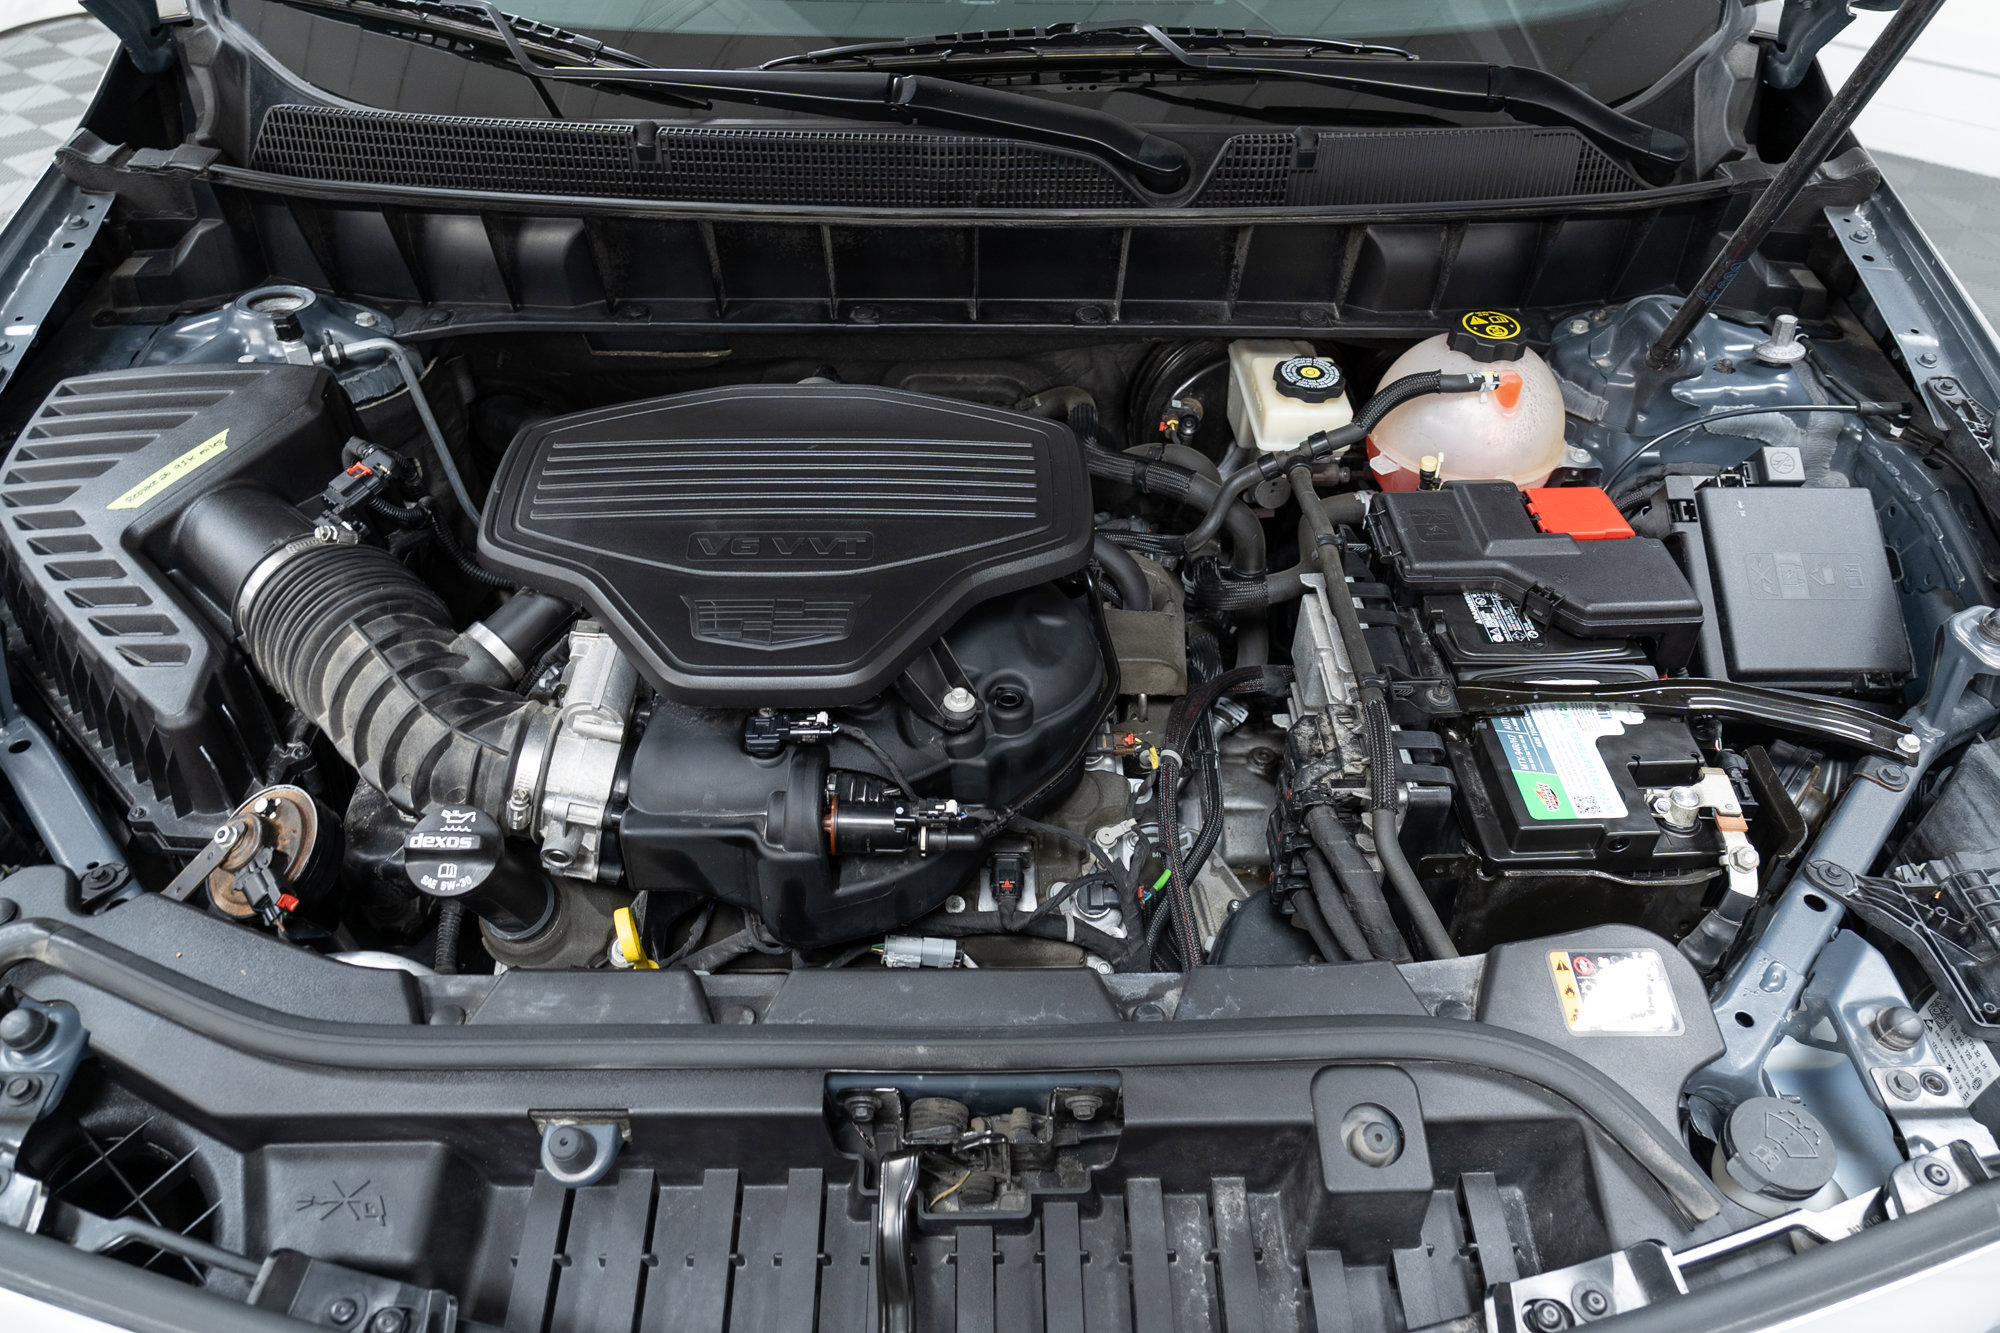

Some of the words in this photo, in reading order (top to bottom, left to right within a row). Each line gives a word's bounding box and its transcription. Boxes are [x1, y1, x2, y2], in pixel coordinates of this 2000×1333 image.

[697, 537, 760, 555] V6
[771, 537, 867, 555] VVT
[409, 832, 473, 849] dexos
[420, 875, 438, 890] SAE
[440, 876, 472, 891] 5W-30
